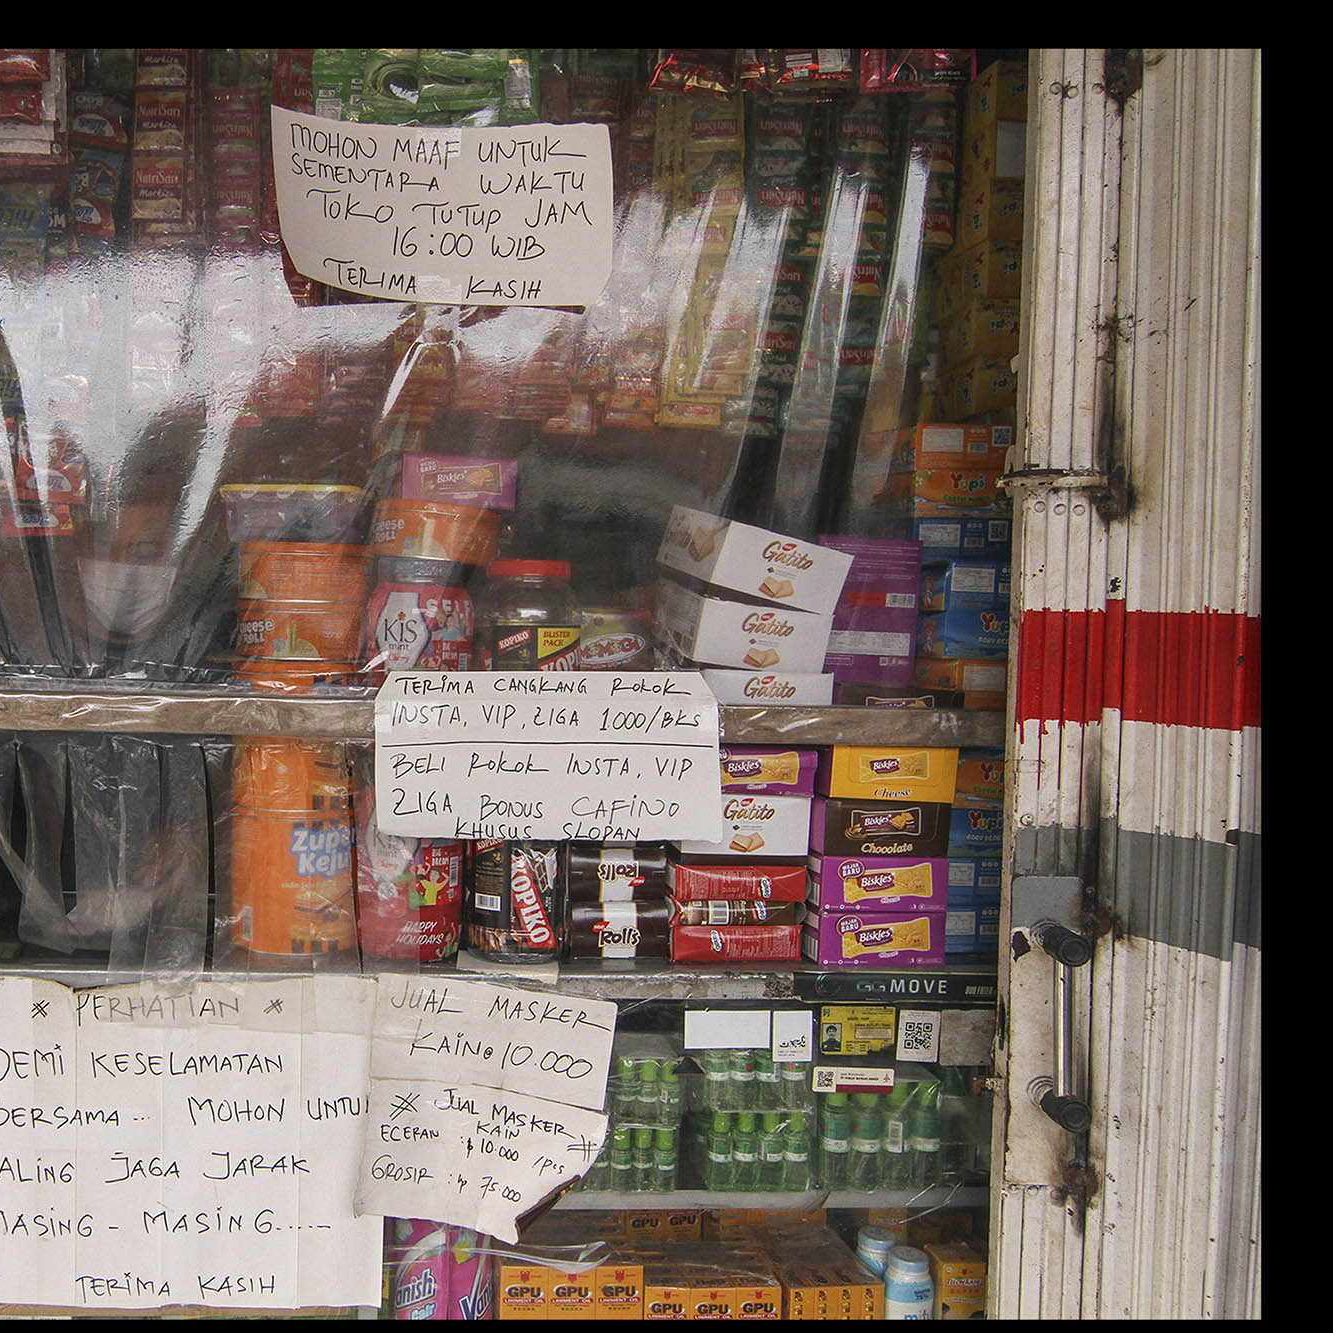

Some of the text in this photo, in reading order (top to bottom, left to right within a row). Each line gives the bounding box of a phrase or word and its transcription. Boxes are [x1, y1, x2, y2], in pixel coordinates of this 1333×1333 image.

[290, 123, 587, 170] MOHON MAAF UNTUK
[291, 153, 584, 195] SEMENTARA WAKTU
[306, 189, 593, 230] TOKO TUTUP JAM
[392, 226, 545, 260] 16:00 WIB
[323, 257, 541, 298] TERIMA KASIH
[741, 612, 794, 637] Gatito
[499, 628, 531, 651] KOPIKO
[395, 675, 588, 695] TERIMA CANGKANG
[390, 753, 446, 777] BELI
[655, 756, 693, 780] VIP
[392, 788, 680, 821] ZIGA BONUS CAFINO
[454, 820, 640, 841] KHUSUS SLOPAN
[861, 873, 893, 886] Biskies
[890, 980, 947, 994] MOVE
[76, 993, 240, 1026] PERHATIAN
[391, 981, 612, 1032] JUAL MASKER
[90, 1051, 283, 1078] KESELAMATAN
[188, 1097, 285, 1125] MOHON
[105, 1152, 181, 1184] JAGA
[204, 1152, 310, 1180] JARAK
[75, 1272, 276, 1303] TERIMA KASIH
[507, 1287, 541, 1297] GPU
